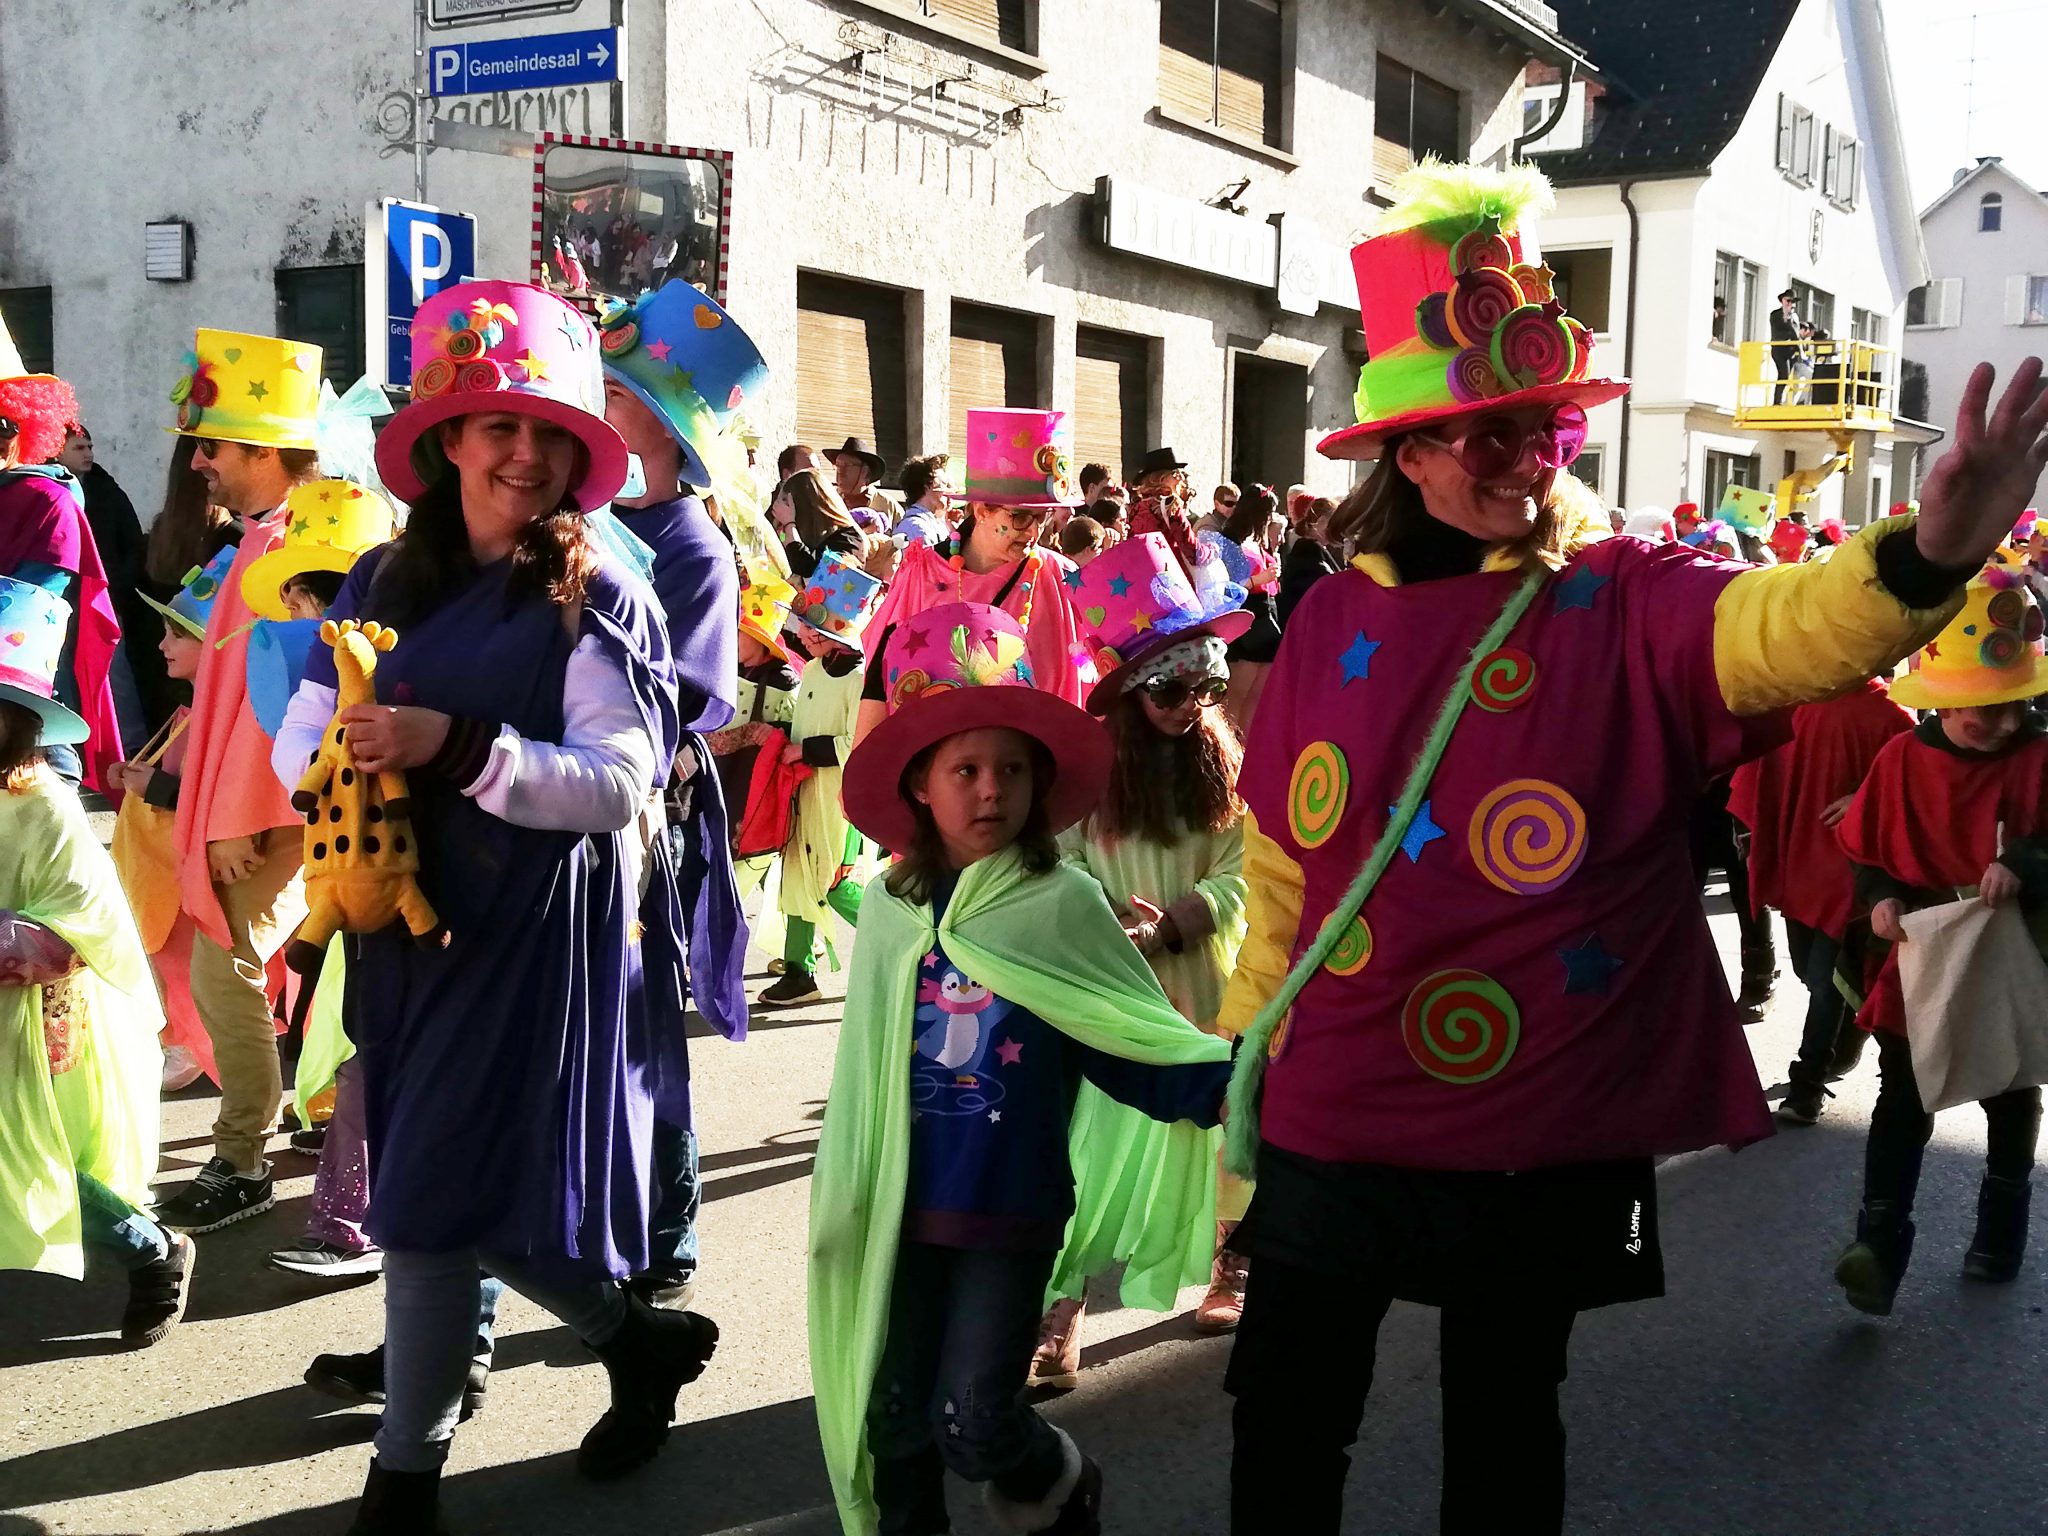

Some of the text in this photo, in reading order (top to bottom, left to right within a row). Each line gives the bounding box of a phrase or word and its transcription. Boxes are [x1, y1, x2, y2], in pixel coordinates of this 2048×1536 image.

[435, 48, 581, 93] P Gemeindesaal
[410, 219, 452, 308] P
